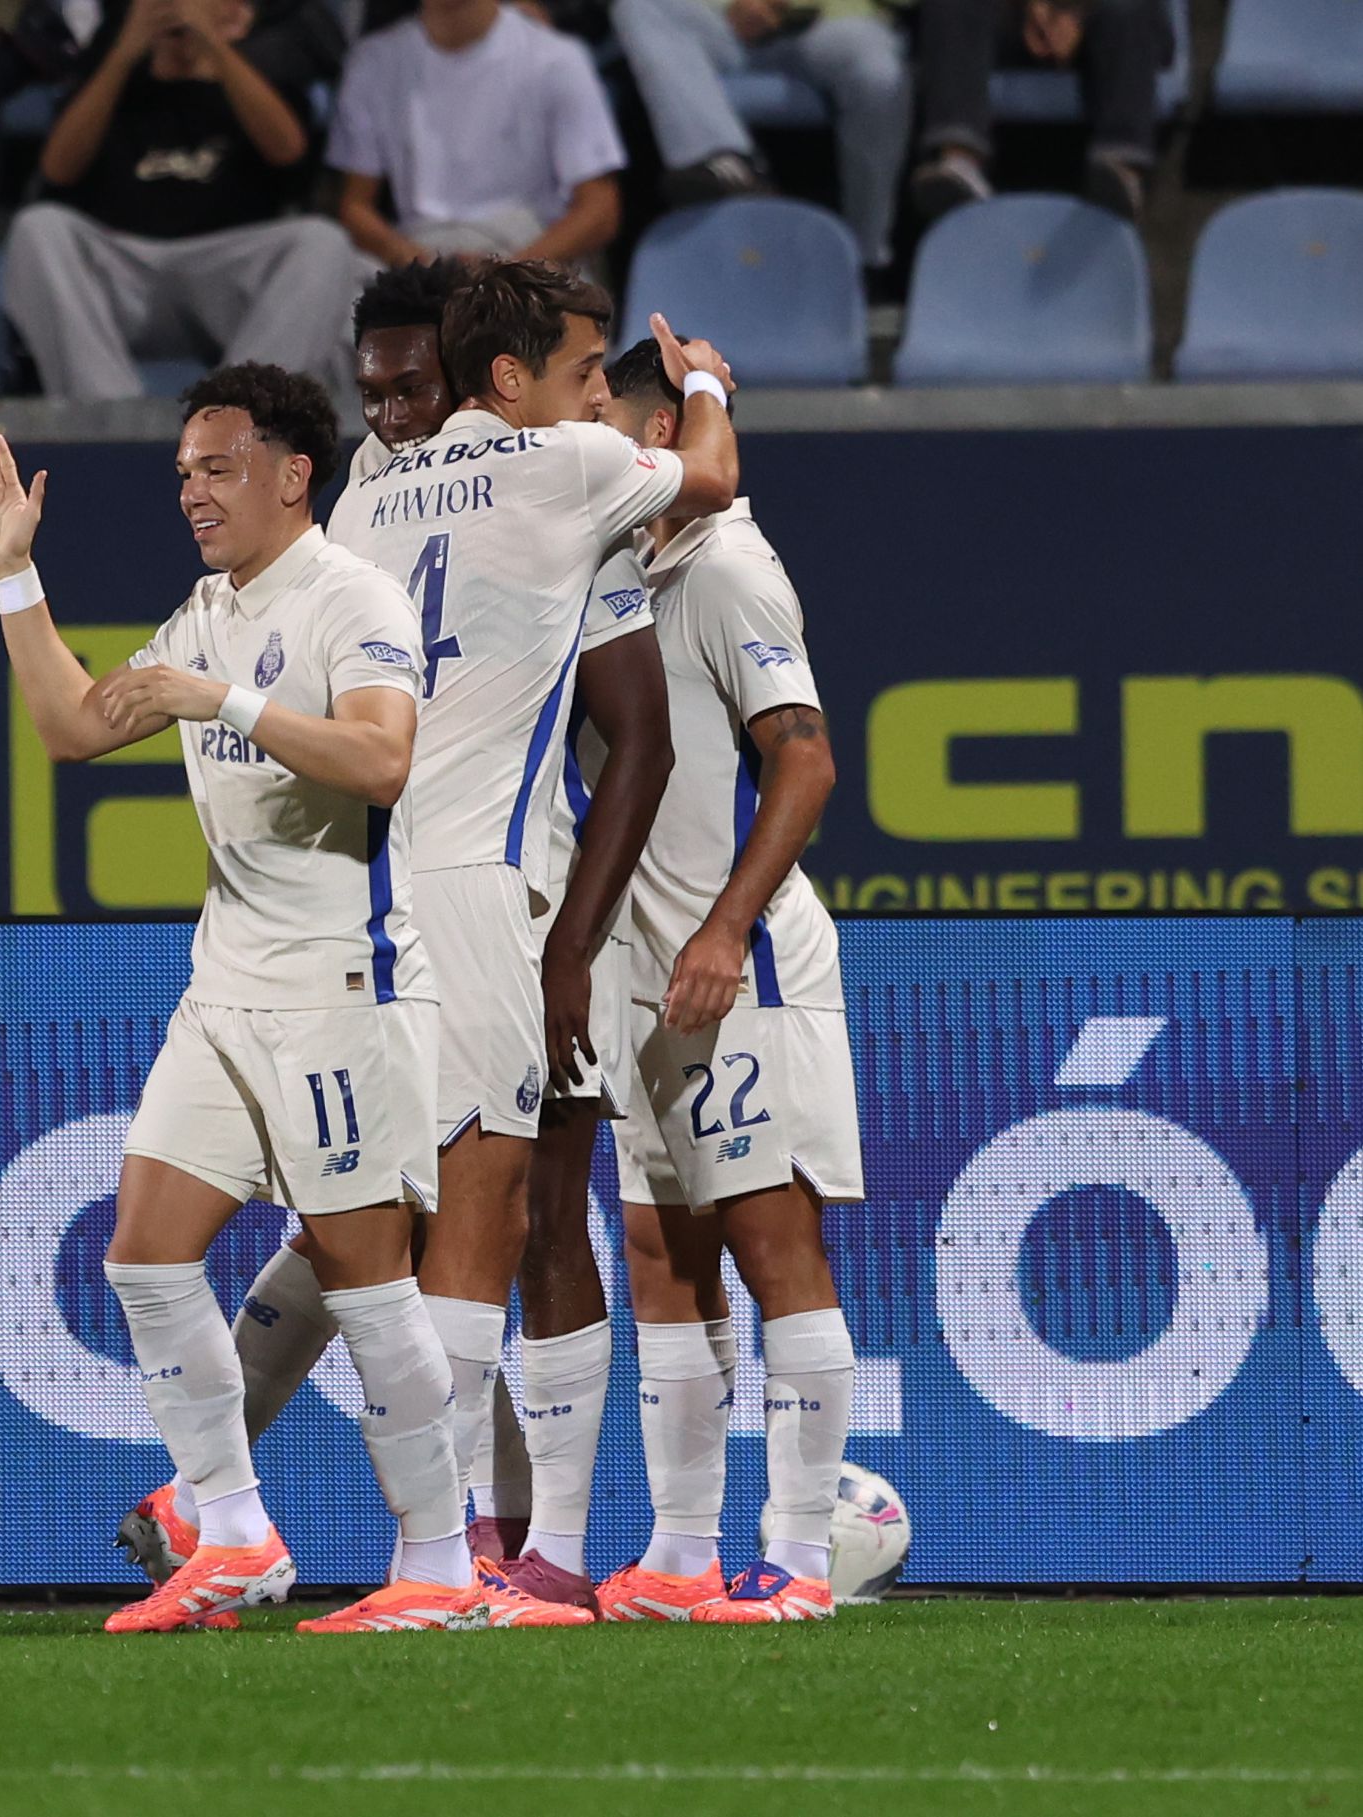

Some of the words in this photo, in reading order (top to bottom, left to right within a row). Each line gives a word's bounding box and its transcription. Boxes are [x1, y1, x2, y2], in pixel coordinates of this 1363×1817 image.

[442, 431, 546, 466] BOCK
[370, 475, 494, 528] KIWIOR
[407, 531, 465, 700] 4
[305, 1068, 360, 1148] 11
[682, 1051, 771, 1139] 22
